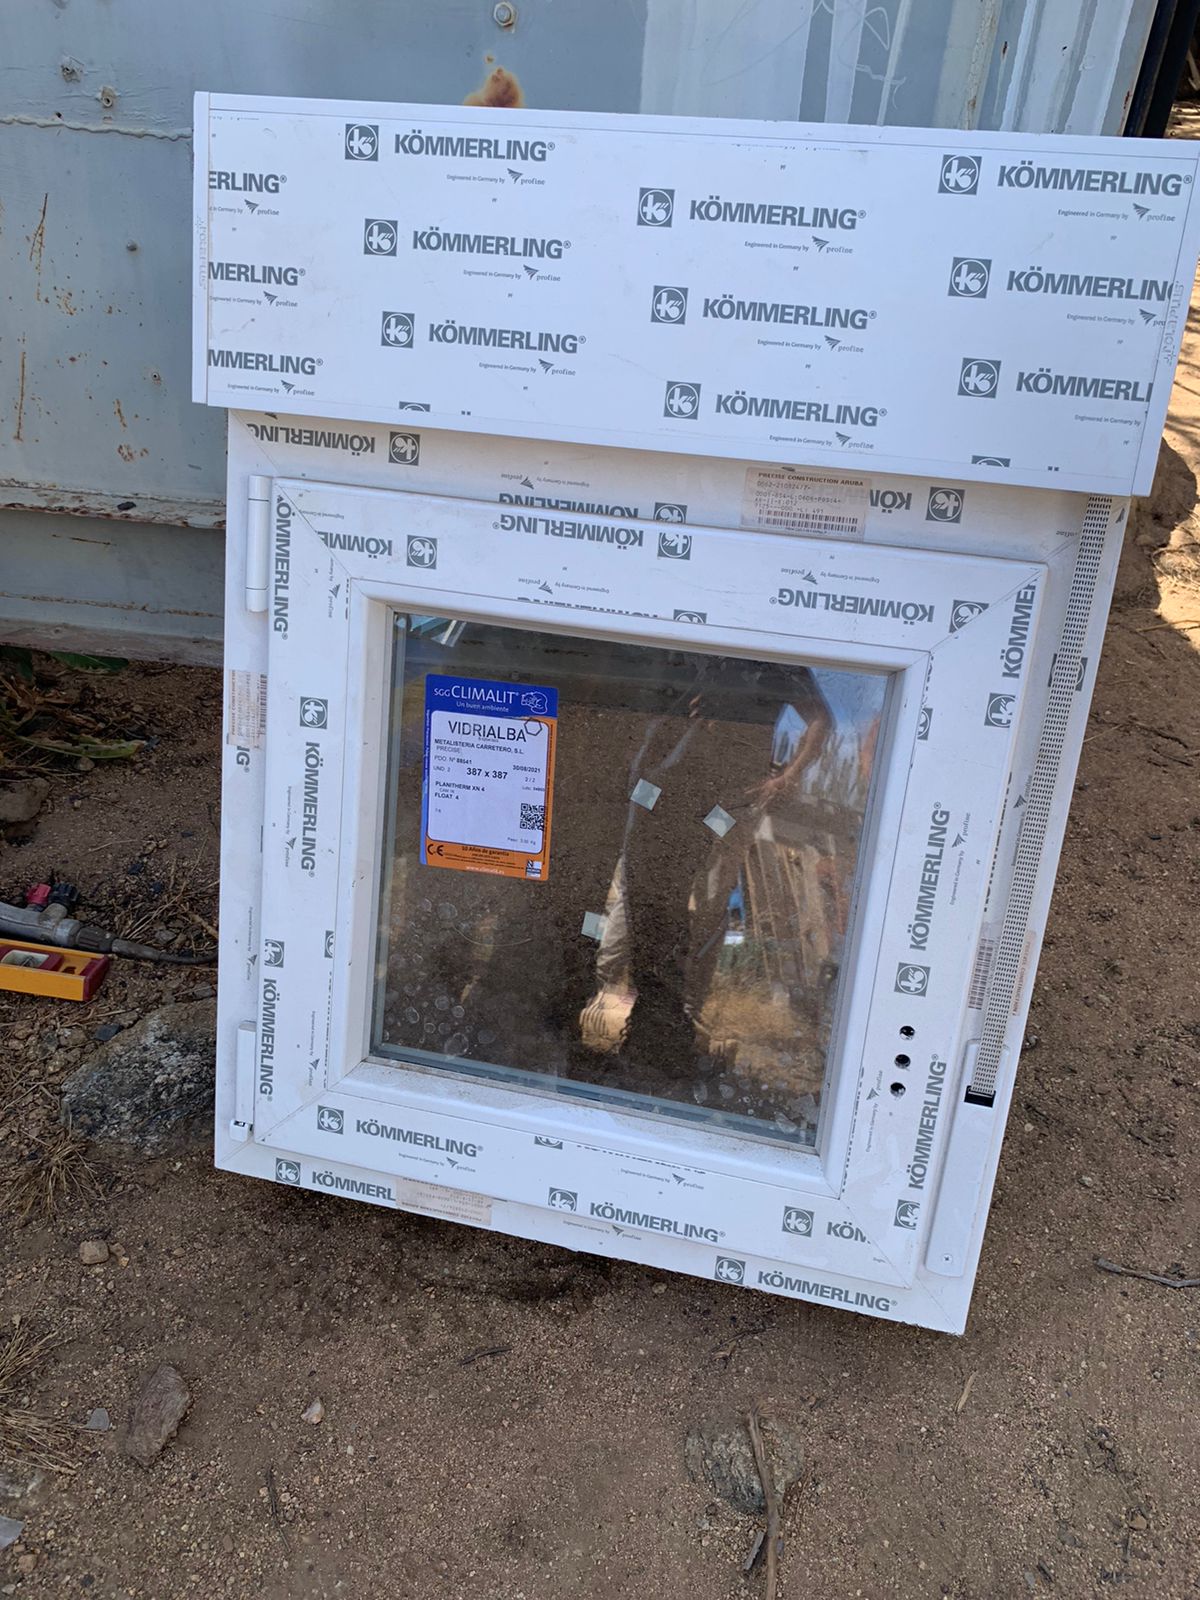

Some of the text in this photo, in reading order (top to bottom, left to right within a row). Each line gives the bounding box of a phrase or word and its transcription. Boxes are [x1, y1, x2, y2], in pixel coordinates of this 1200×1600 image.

[788, 474, 839, 484] CONSTRUCTION
[448, 720, 526, 742] VIDRIALBA
[434, 739, 475, 748] METALISTERIA
[466, 767, 482, 776] 387
[492, 770, 508, 779] 387
